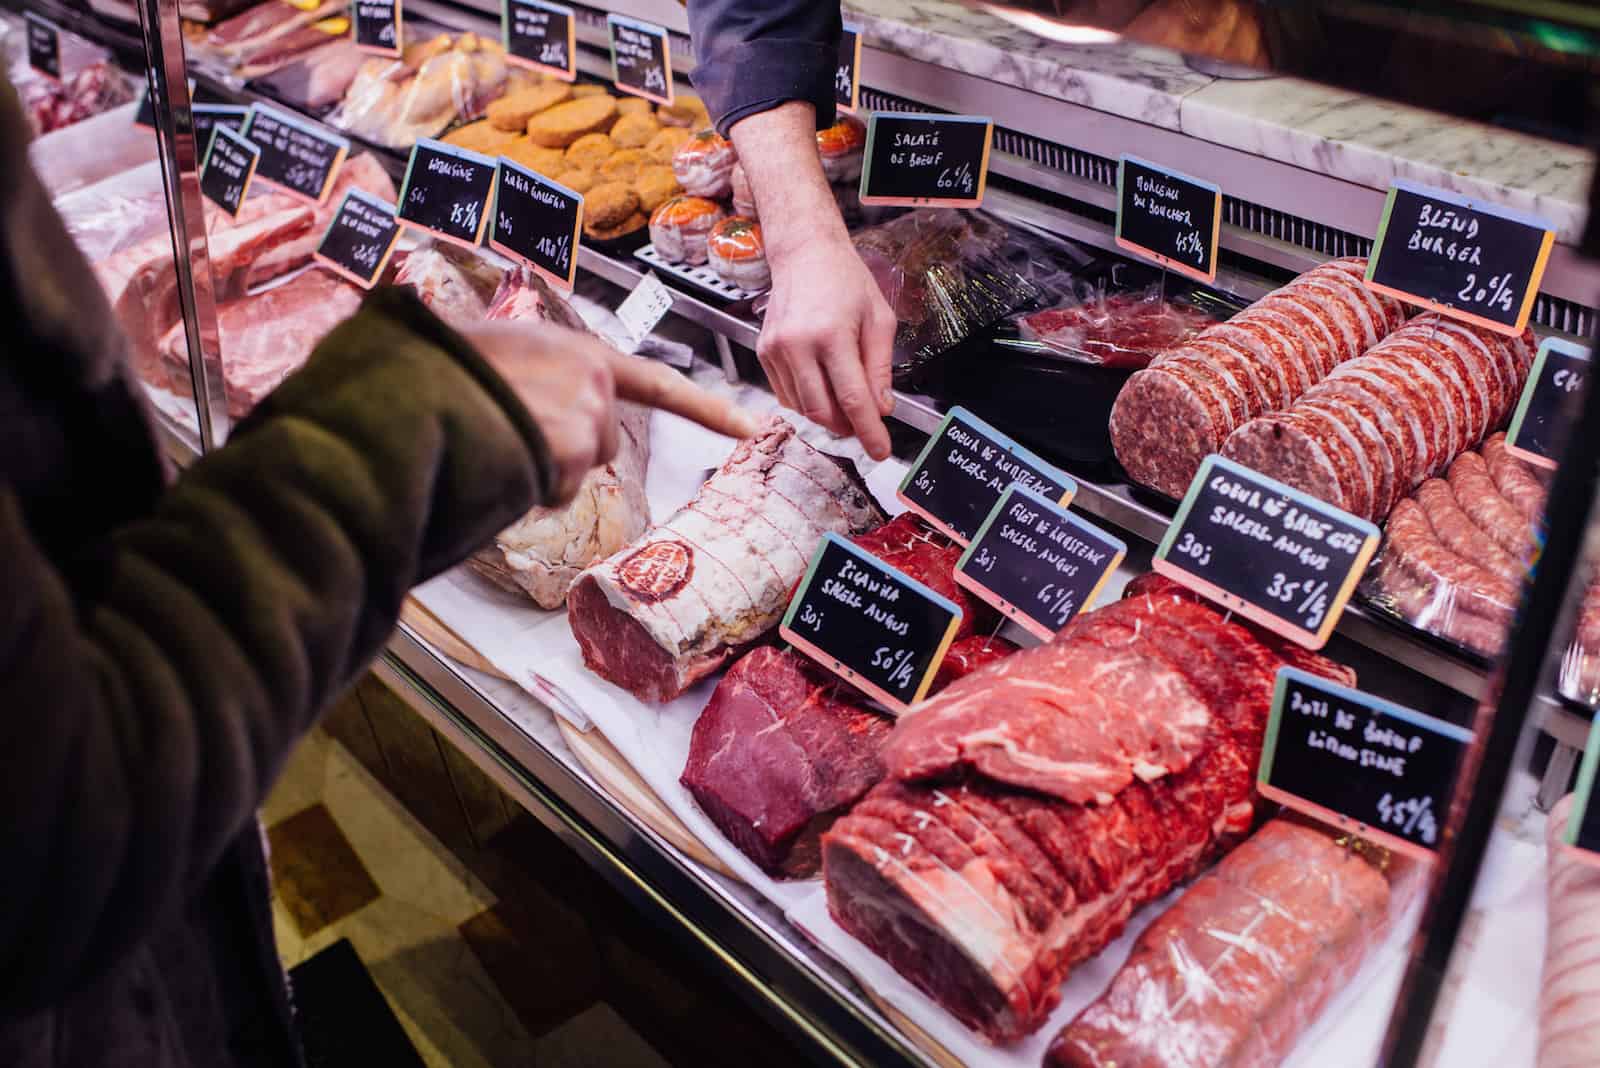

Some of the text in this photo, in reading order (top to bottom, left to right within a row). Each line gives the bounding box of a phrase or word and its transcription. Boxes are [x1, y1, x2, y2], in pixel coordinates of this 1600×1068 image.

[1136, 175, 1180, 201] MORCEAU
[1148, 198, 1193, 227] BOUCHER
[1418, 203, 1480, 240] BLEND
[1407, 229, 1481, 266] BURGER
[946, 425, 981, 453] COEUR
[981, 445, 997, 461] DE
[1008, 501, 1040, 526] FILET
[1034, 519, 1051, 535] DE
[1036, 547, 1080, 577] ANGUS
[863, 603, 910, 637] ANGUS
